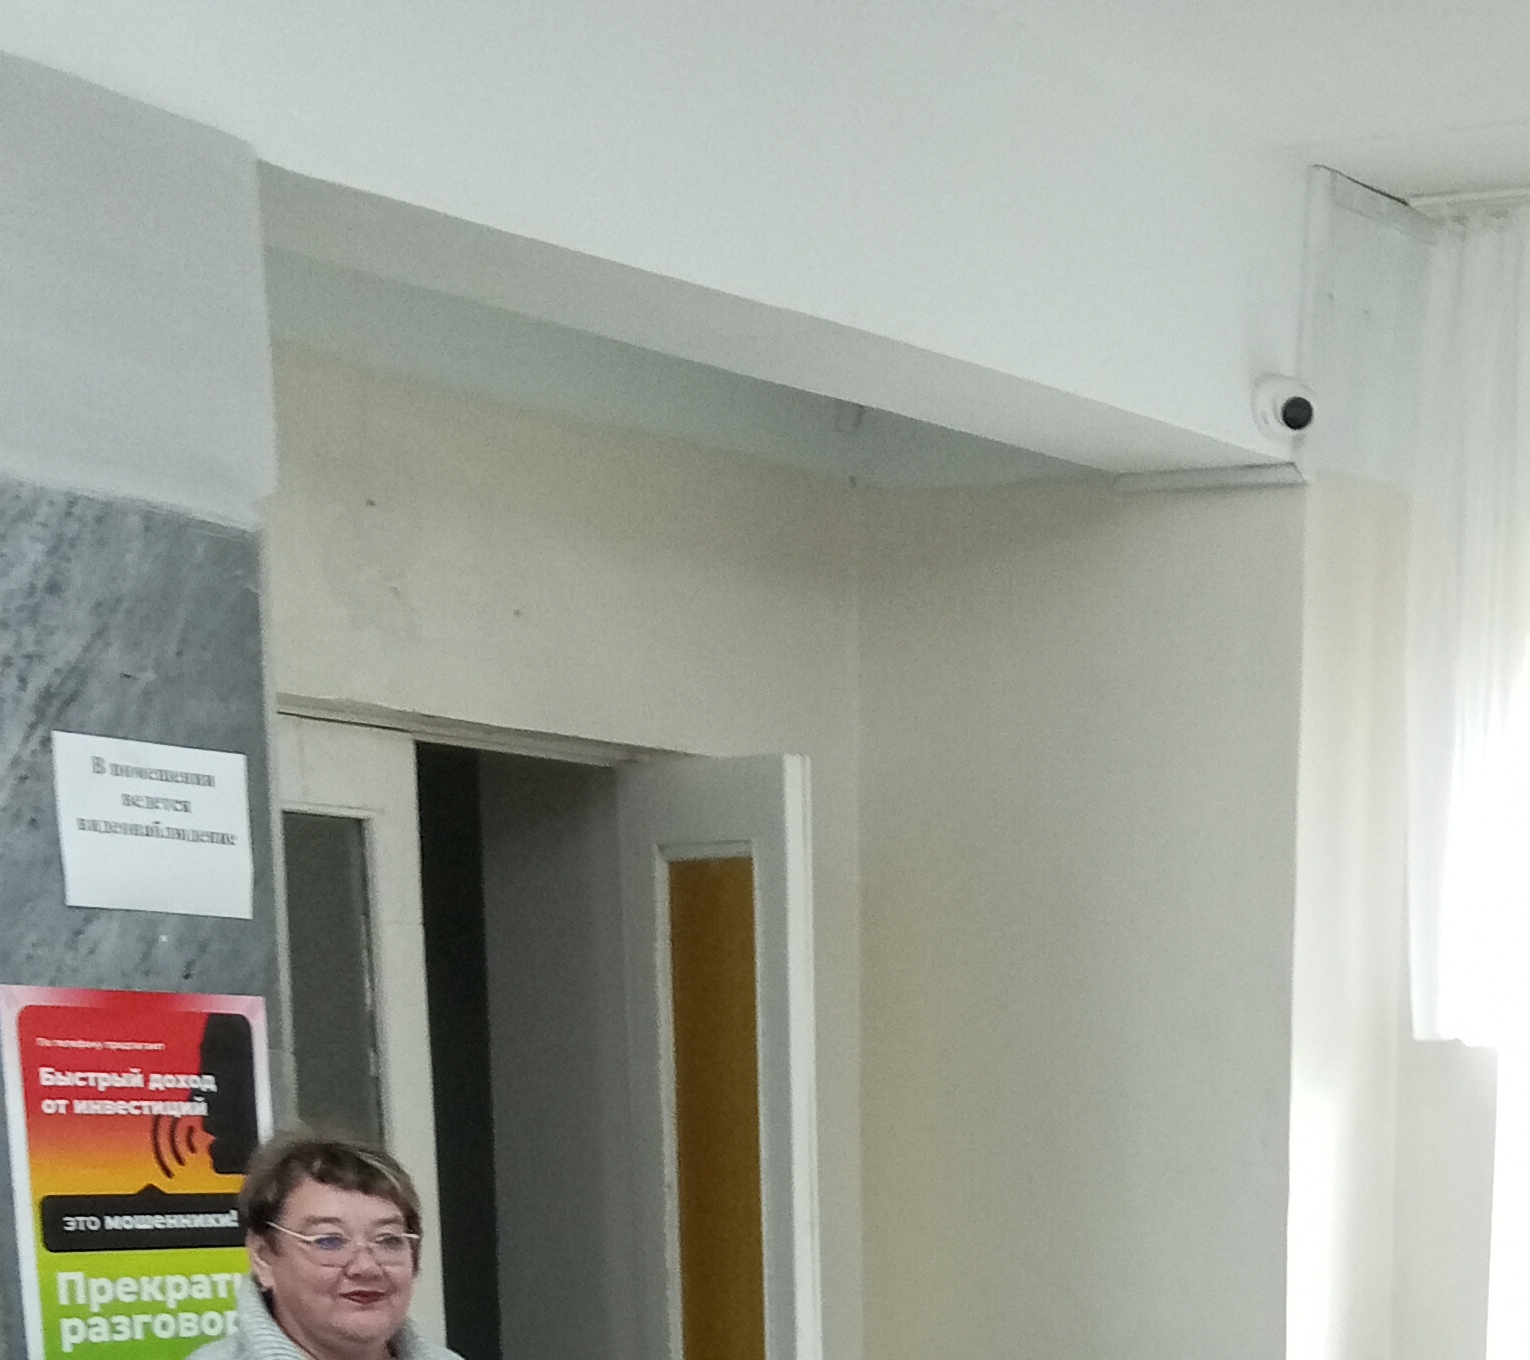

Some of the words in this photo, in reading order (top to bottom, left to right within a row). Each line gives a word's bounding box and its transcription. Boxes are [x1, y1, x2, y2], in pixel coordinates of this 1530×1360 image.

[90, 756, 106, 774] В
[38, 1066, 144, 1091] Быстрый
[149, 1074, 217, 1092] доход
[41, 1099, 70, 1115] от
[73, 1096, 209, 1118] инвестиций
[103, 1209, 240, 1230] мошенники!
